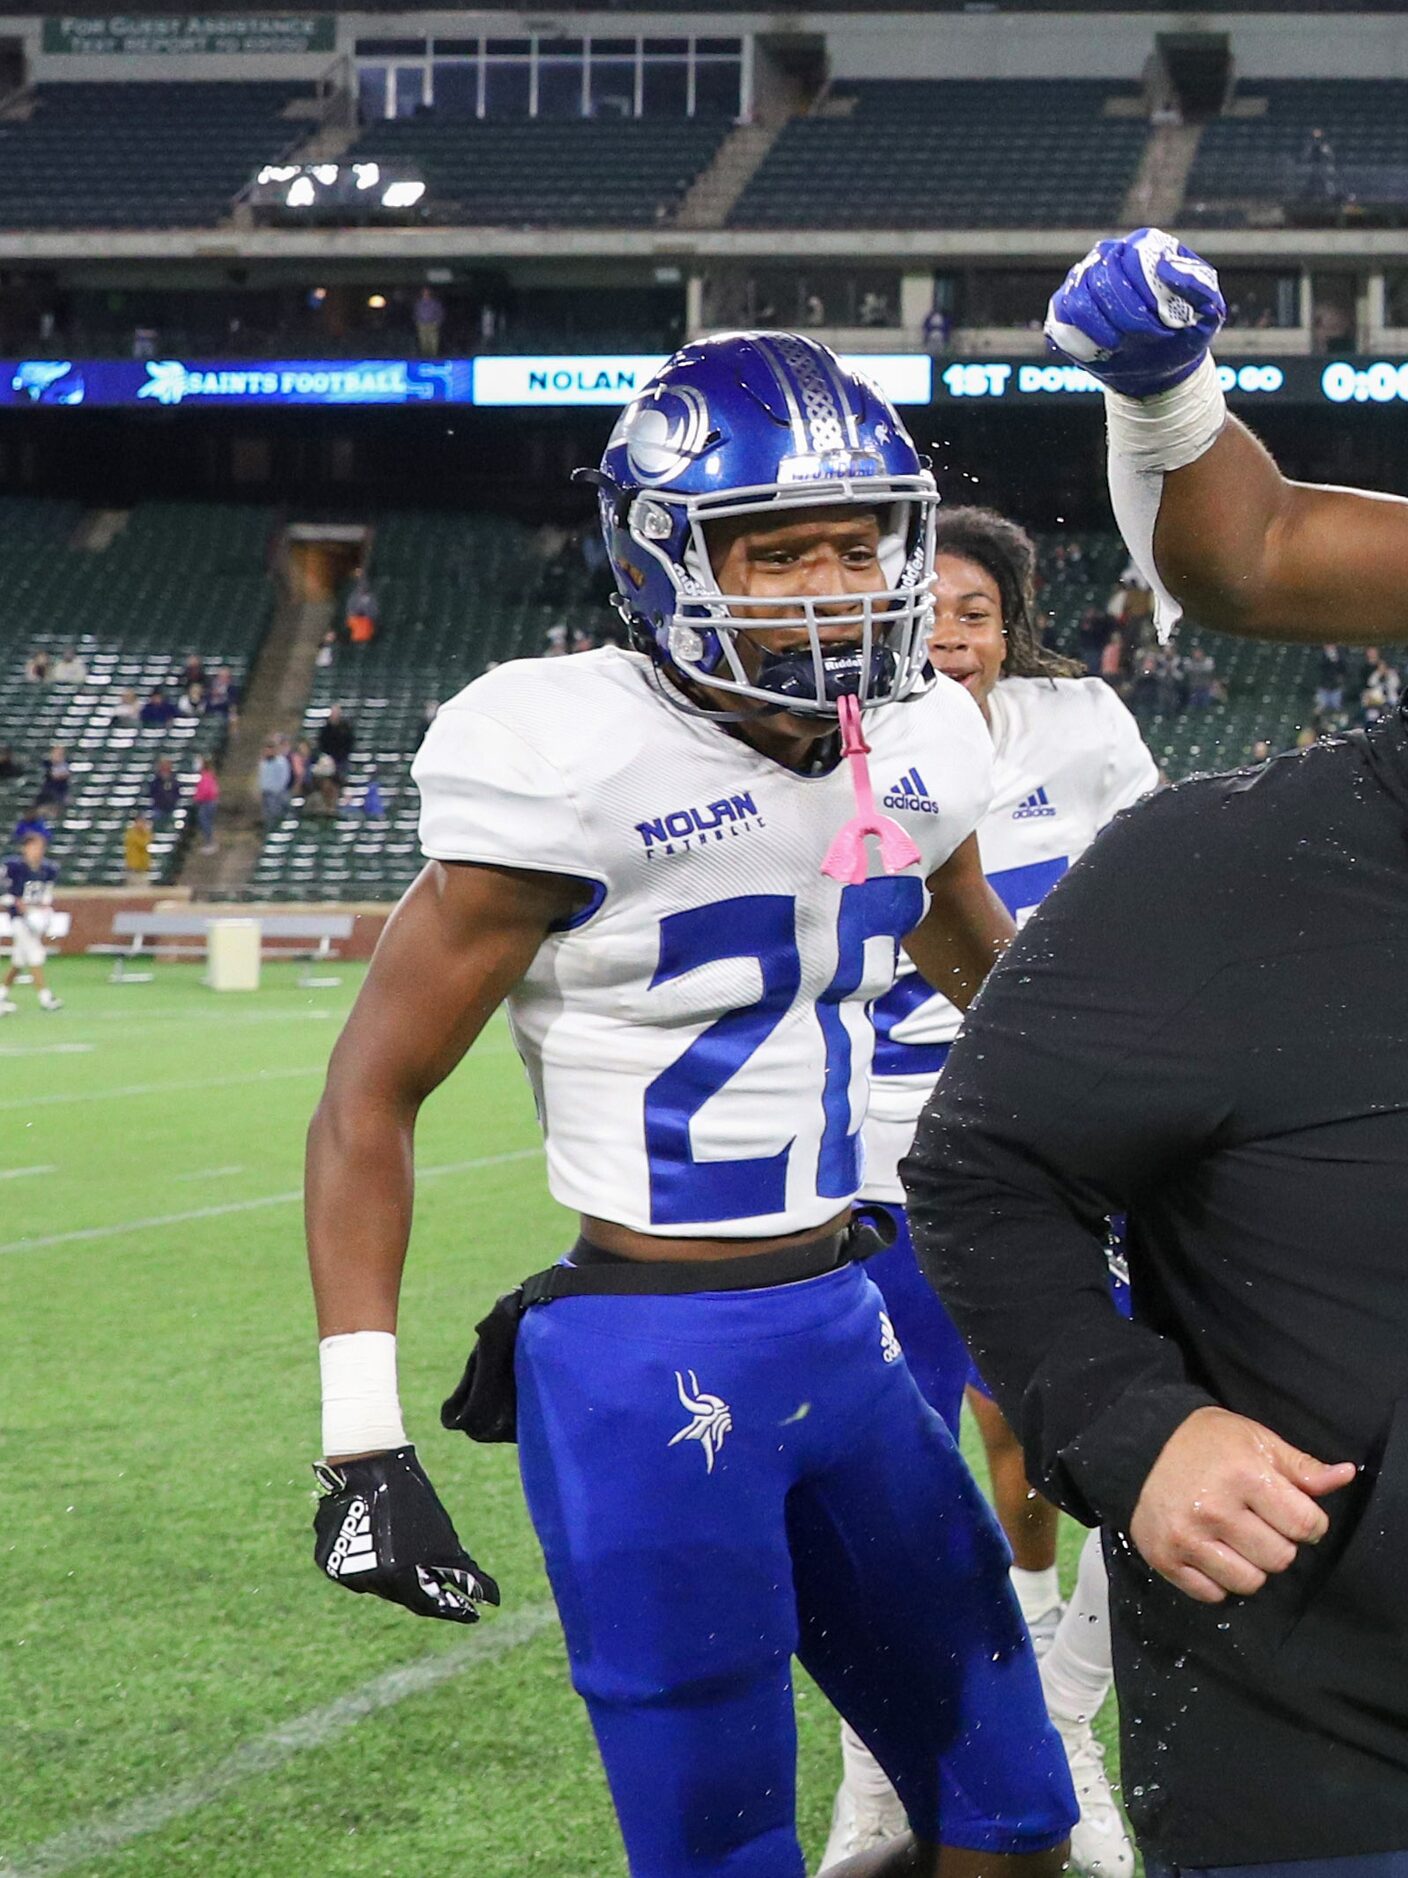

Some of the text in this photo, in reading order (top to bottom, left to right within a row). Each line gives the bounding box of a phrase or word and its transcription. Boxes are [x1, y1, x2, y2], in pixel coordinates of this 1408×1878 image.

[189, 372, 407, 394] SAINTS FOOTBALL
[528, 370, 636, 391] NOLAN
[943, 364, 1012, 396] 1ST
[1217, 365, 1237, 392] O
[1238, 365, 1284, 392] GO
[883, 794, 939, 815] adidas
[1012, 806, 1056, 820] adidas
[634, 791, 758, 847] NOLAN
[326, 1500, 366, 1579] adidas
